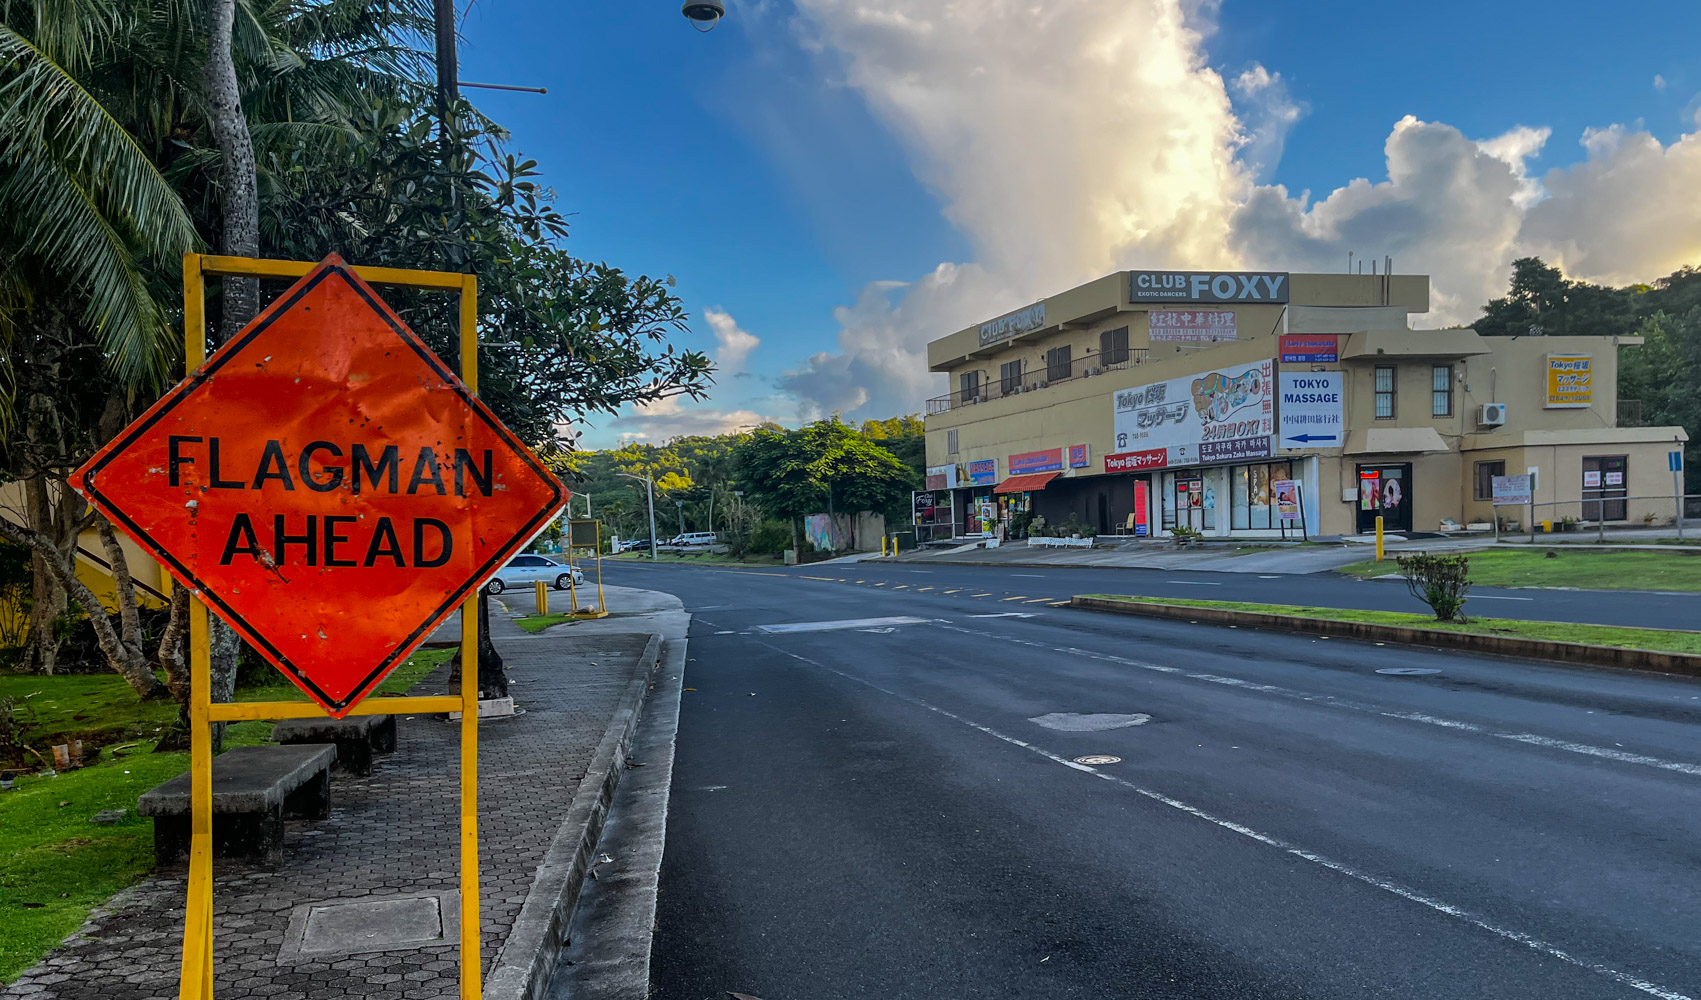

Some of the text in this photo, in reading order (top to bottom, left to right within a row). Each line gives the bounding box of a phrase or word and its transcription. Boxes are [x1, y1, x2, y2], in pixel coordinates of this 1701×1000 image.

[1137, 274, 1285, 300] CLUB FOXY
[1551, 360, 1573, 371] Tokyo
[1293, 379, 1330, 389] TOKYO
[1116, 391, 1144, 410] Tokyo
[1284, 393, 1339, 403] MASSAGE
[1136, 402, 1190, 430] マッサージ
[1106, 458, 1125, 469] Tokyo
[1201, 453, 1216, 462] Tokyo
[1216, 452, 1233, 460] Sakura
[1245, 449, 1268, 458] Massage
[168, 435, 493, 497] FLAGMAN
[219, 513, 453, 568] AHEAD
